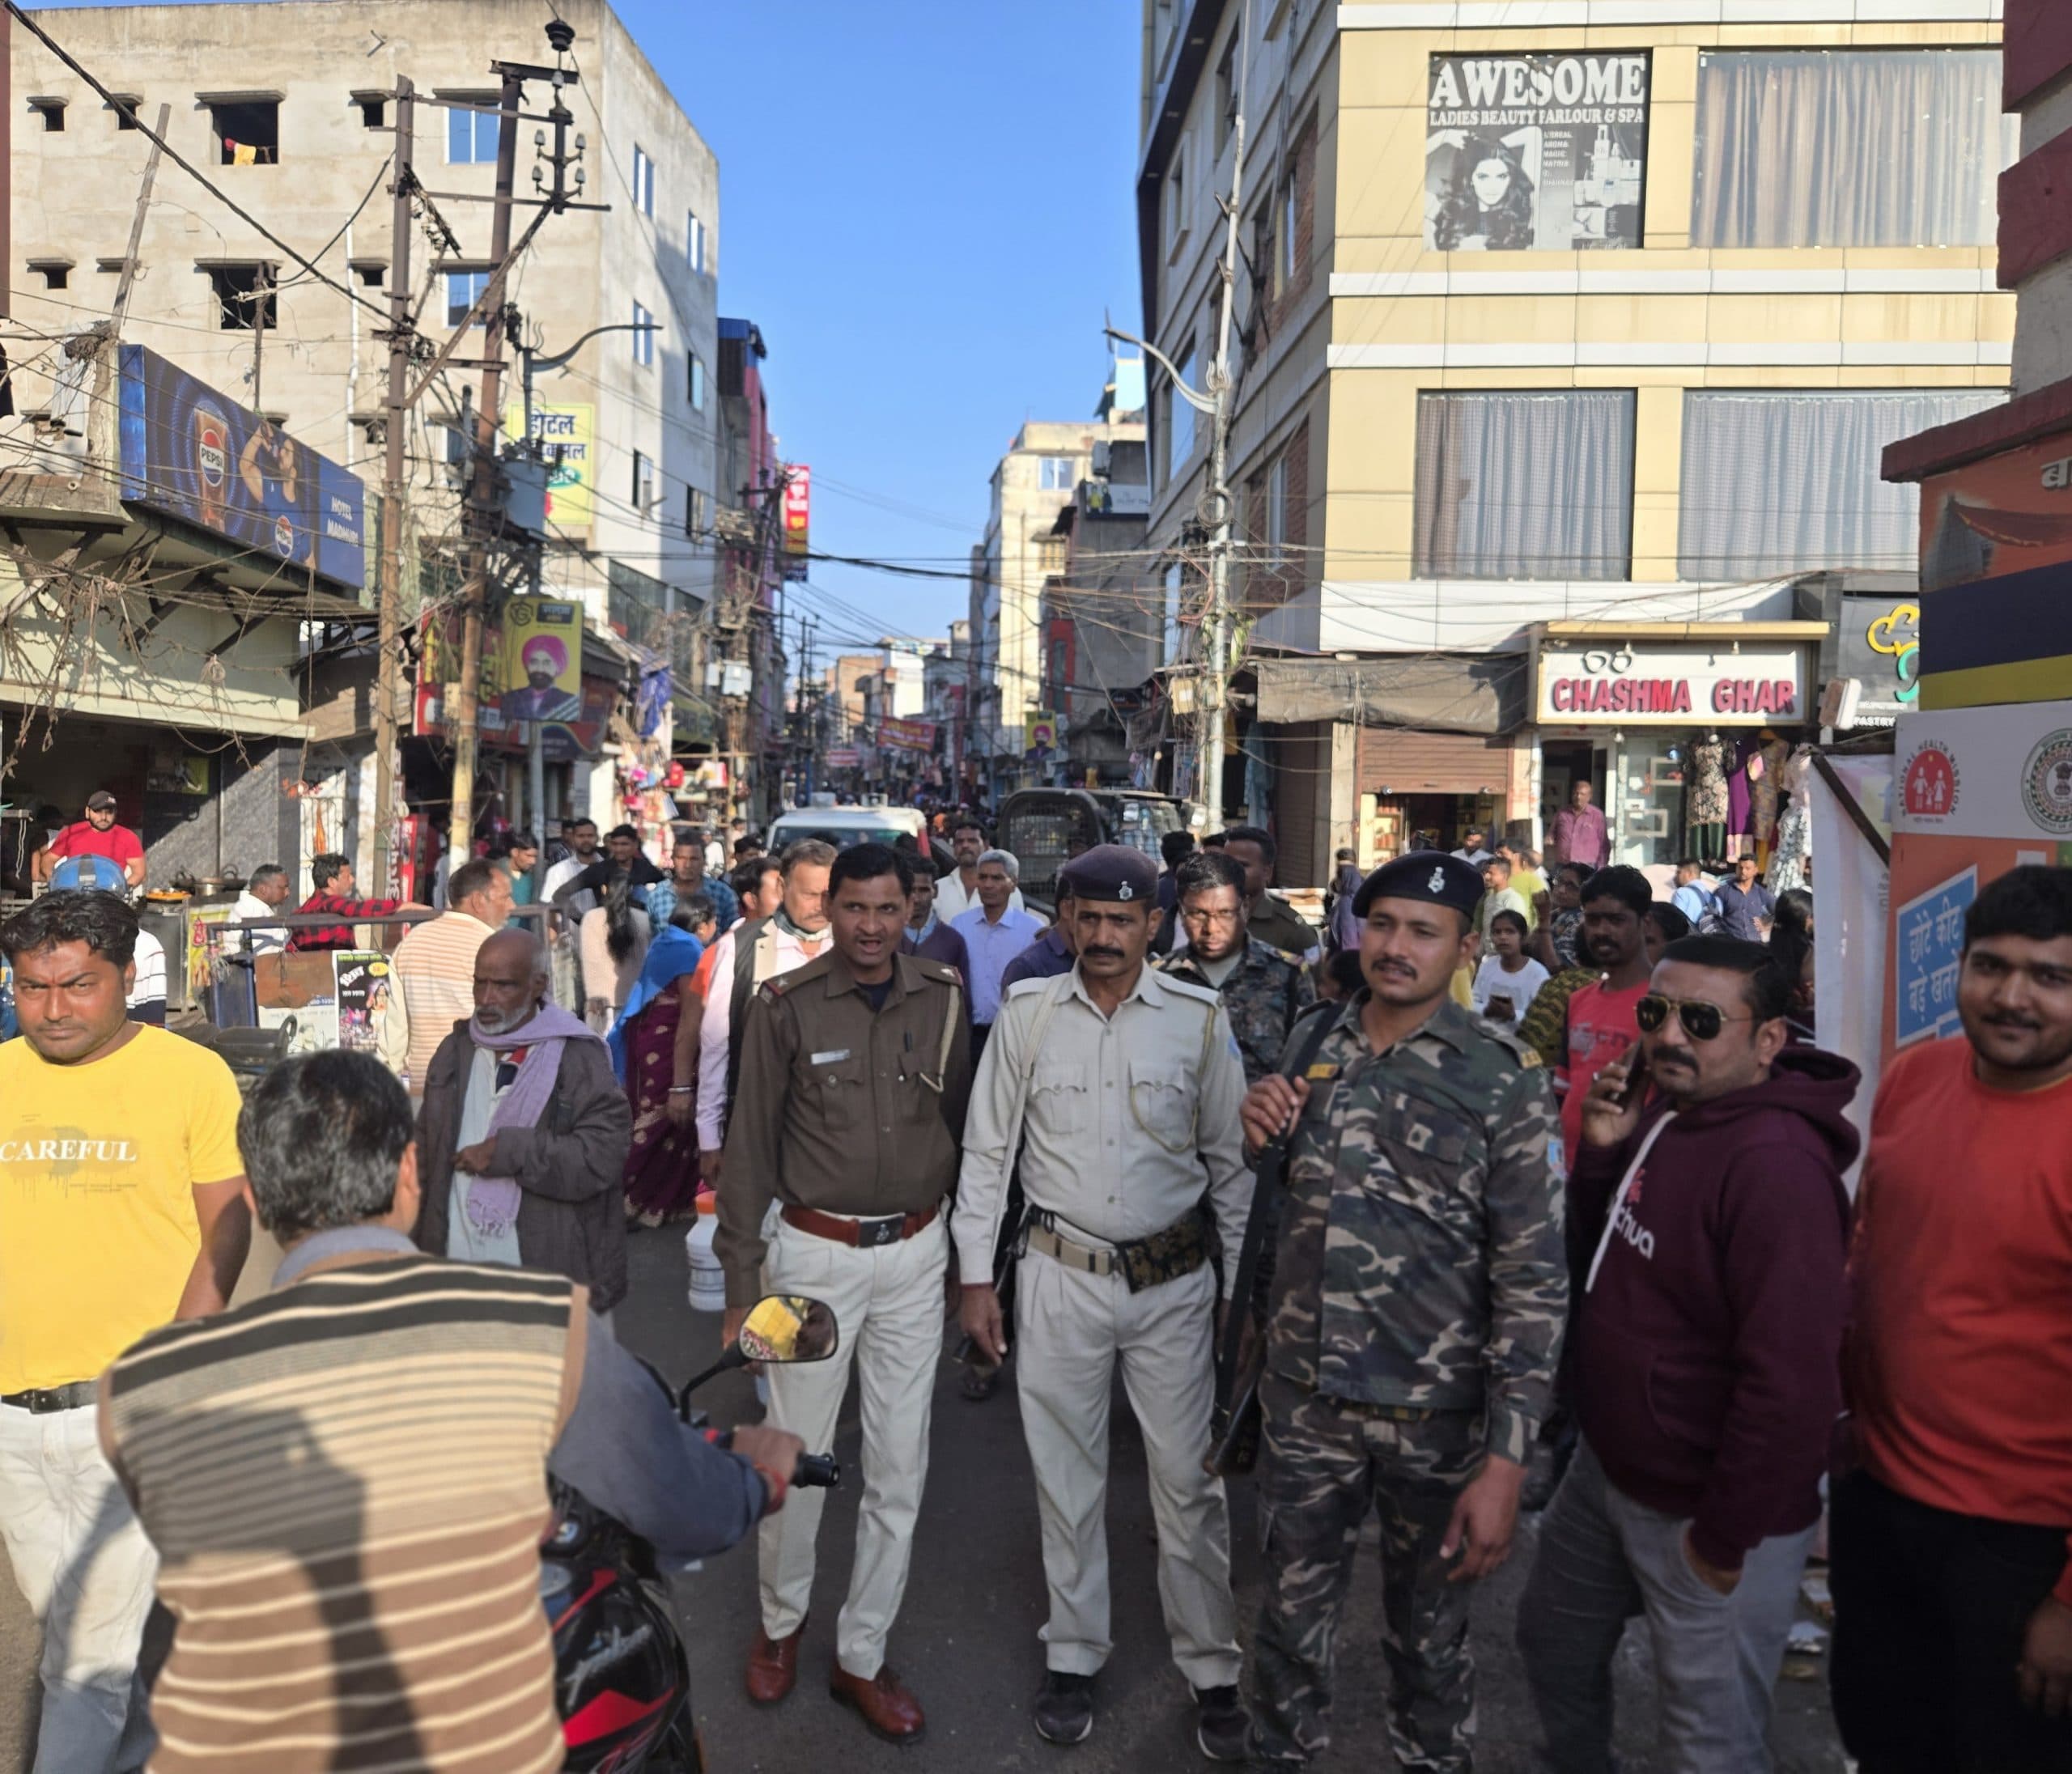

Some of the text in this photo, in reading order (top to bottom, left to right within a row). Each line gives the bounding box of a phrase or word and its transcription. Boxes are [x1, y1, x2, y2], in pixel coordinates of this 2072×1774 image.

[1429, 57, 1646, 108] AWESOME
[1429, 108, 1644, 126] LADIES BEAUTY PARLOUR & SPA
[201, 447, 223, 467] PEPSI
[331, 495, 353, 521] HOTEL
[1553, 678, 1795, 713] CHASHMA GHAR
[1918, 739, 1949, 753] HEALTH
[1909, 895, 1962, 964] छोटे कीट
[1909, 965, 1929, 1023] बड़े
[0, 1139, 138, 1162] CAREFUL
